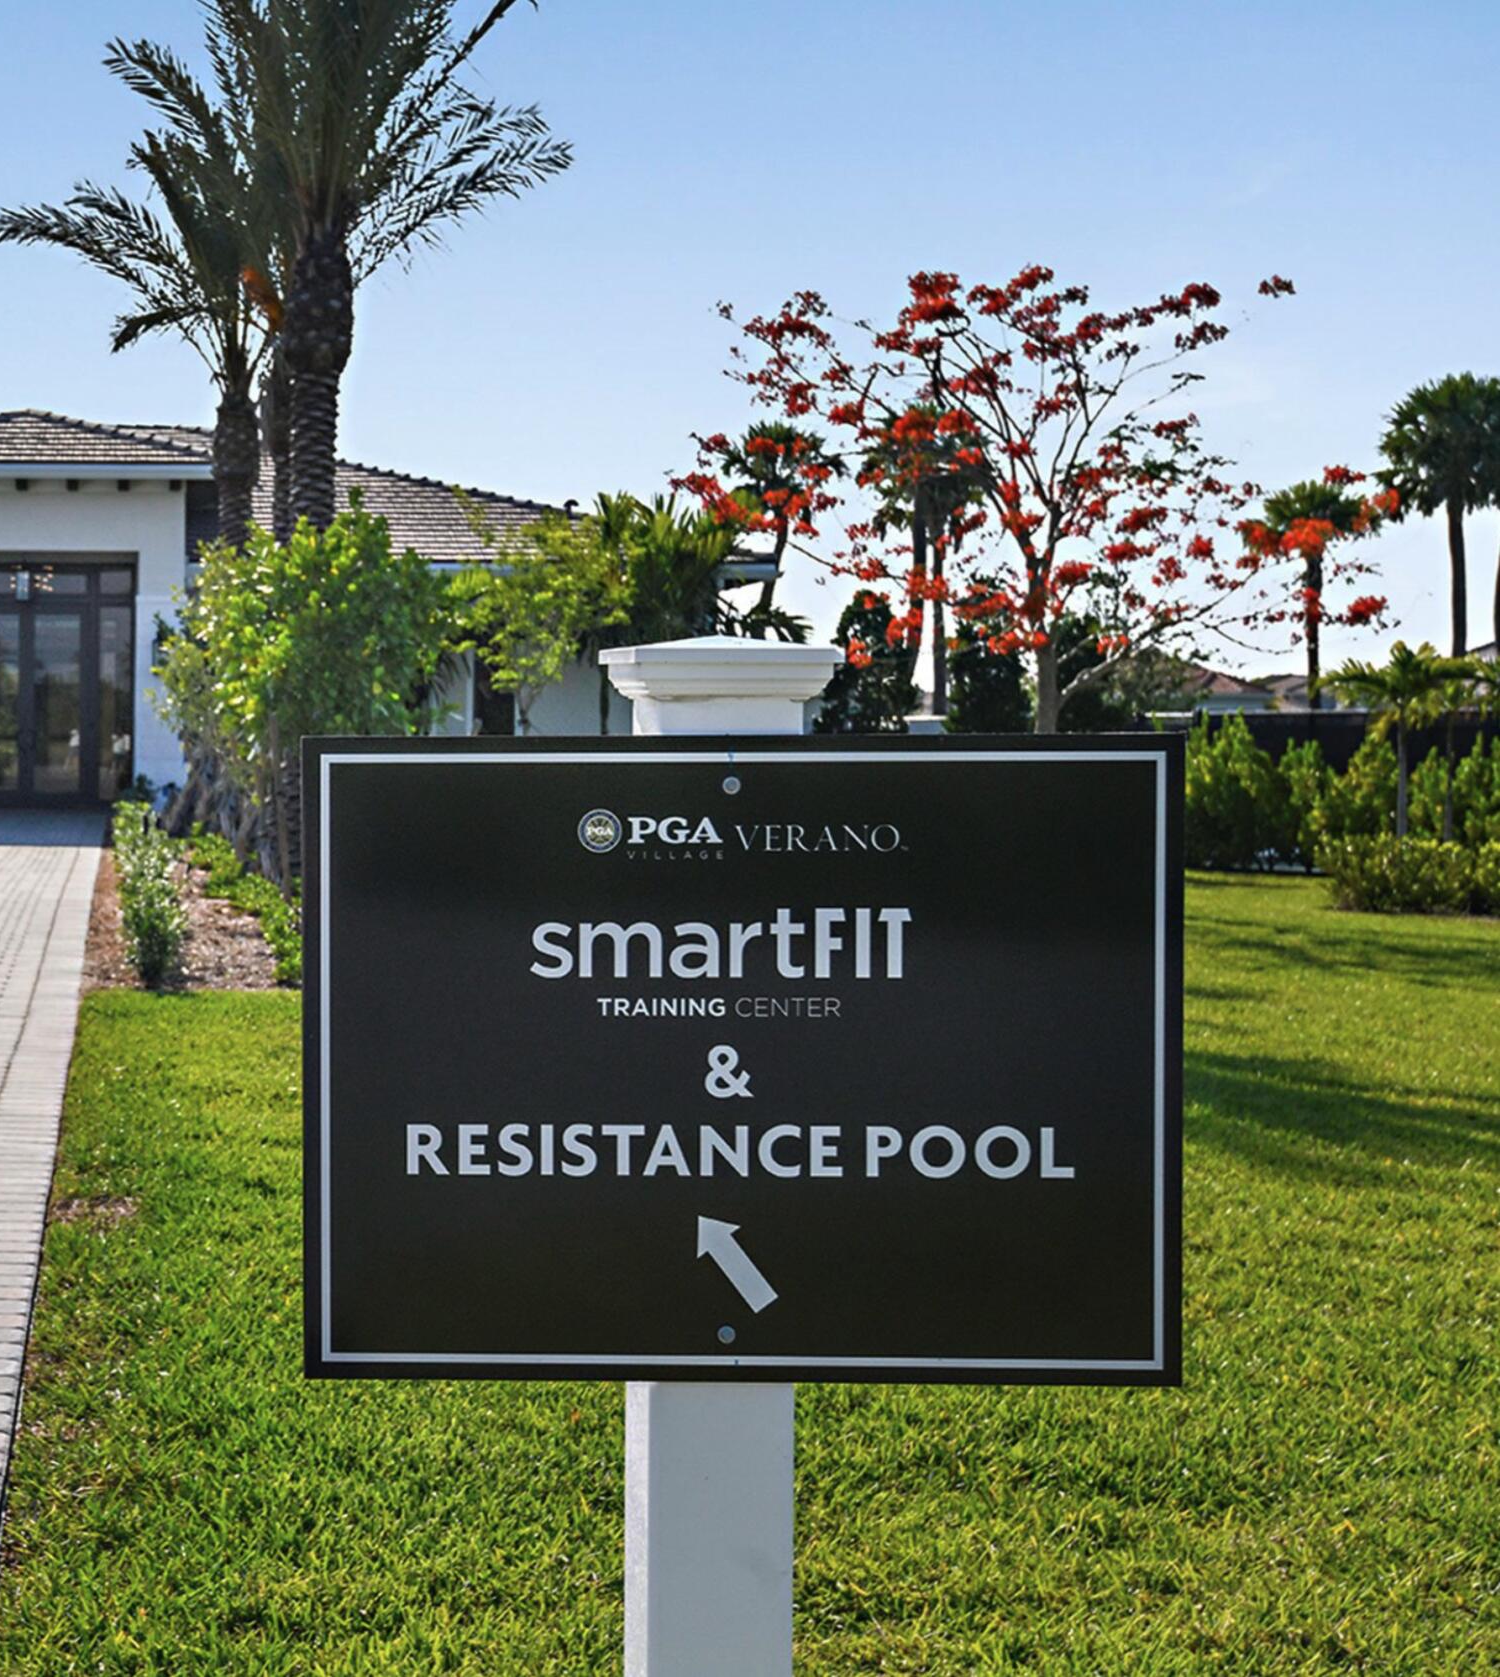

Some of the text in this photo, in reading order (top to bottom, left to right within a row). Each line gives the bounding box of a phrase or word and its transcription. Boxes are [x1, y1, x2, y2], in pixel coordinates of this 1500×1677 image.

[586, 826, 615, 837] PGA
[627, 816, 902, 852] PGA VERANO
[626, 849, 724, 861] VILLAGE
[529, 907, 912, 979] smartFIT
[596, 997, 841, 1018] TRAINING CENTER
[704, 1044, 755, 1099] &
[406, 1123, 1075, 1179] RESISTANCE POOL
